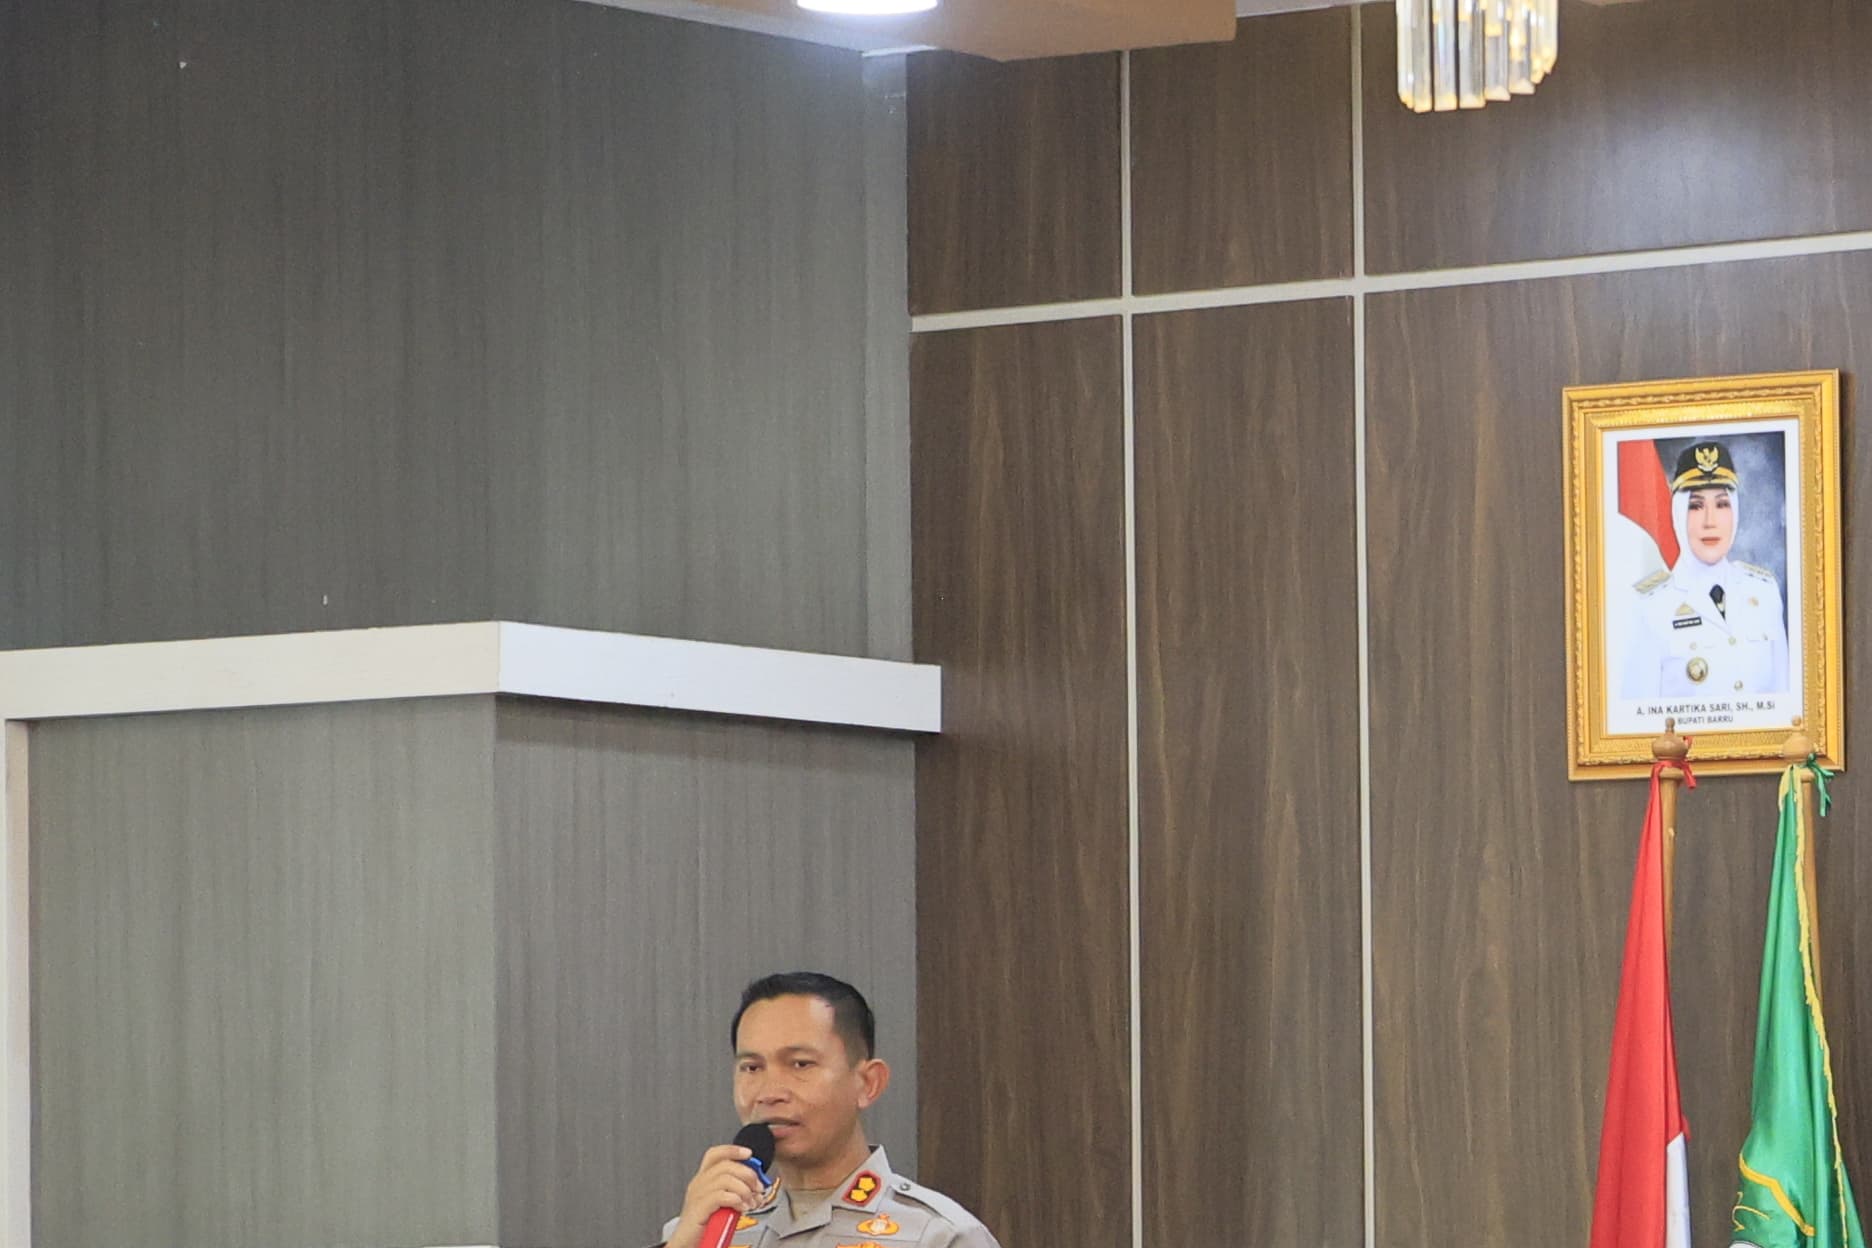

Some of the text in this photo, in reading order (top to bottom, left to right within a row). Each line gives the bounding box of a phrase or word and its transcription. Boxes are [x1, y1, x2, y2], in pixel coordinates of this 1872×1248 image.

[1648, 705, 1663, 715] INA
[1666, 703, 1706, 714] KARTIKA
[1707, 715, 1734, 724] BARRU
